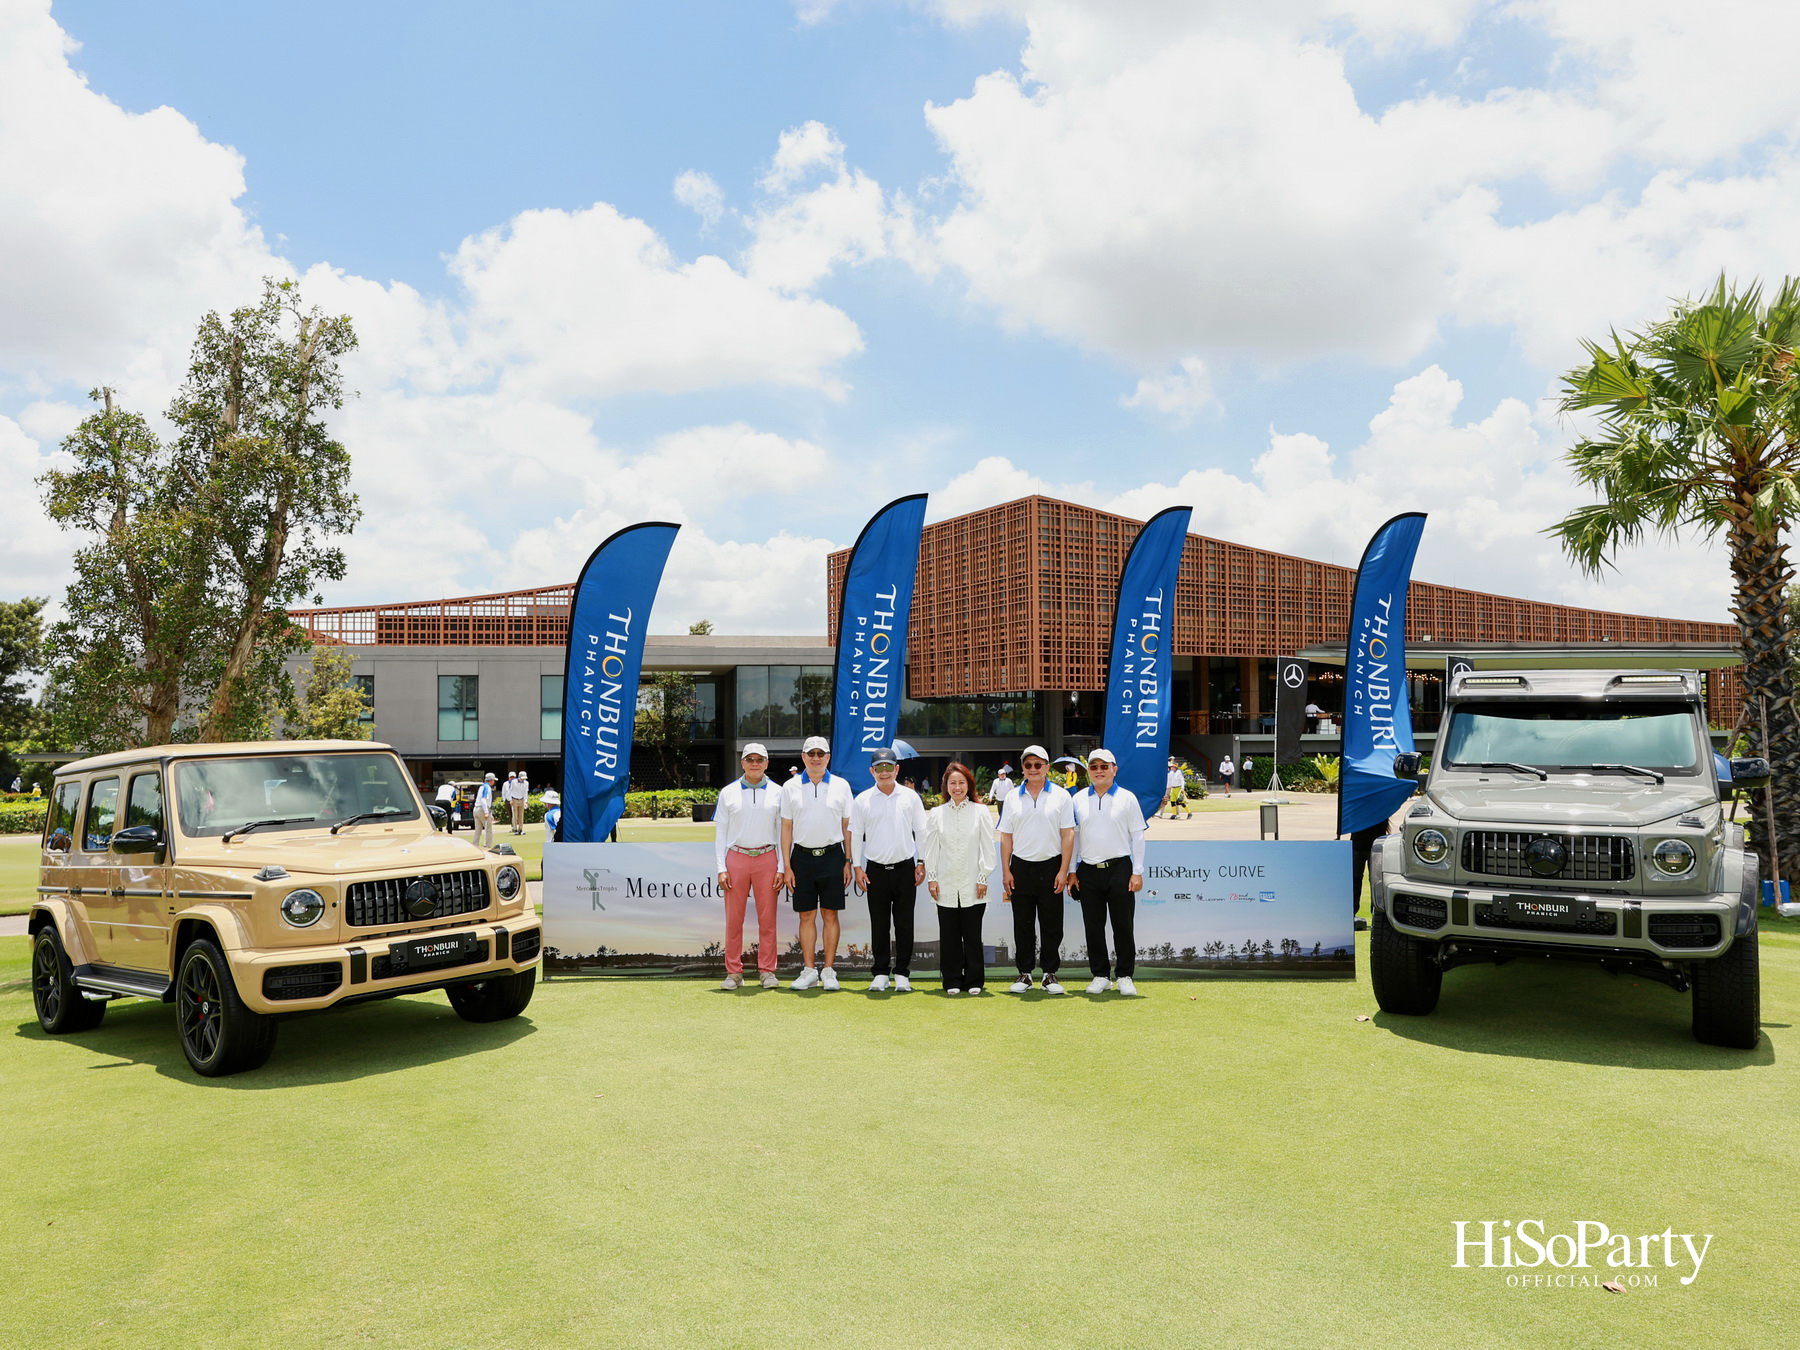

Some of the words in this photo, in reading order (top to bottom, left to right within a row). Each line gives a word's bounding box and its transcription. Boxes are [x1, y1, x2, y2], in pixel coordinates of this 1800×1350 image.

[581, 634, 599, 737] PHANICH
[594, 607, 632, 781] THONBURI
[849, 616, 867, 716] PHANICH
[861, 584, 897, 753] THONBURI
[1122, 618, 1138, 714] PHANICH
[1136, 587, 1163, 749] THONBURI
[1354, 618, 1371, 716] PHANICH
[1368, 593, 1397, 750] THONBURI
[1148, 866, 1211, 882] HiSoParty
[1218, 865, 1266, 877] CURVE
[1516, 902, 1569, 913] THONBURI
[414, 941, 459, 954] THONBURI
[423, 950, 450, 958] PHANICH
